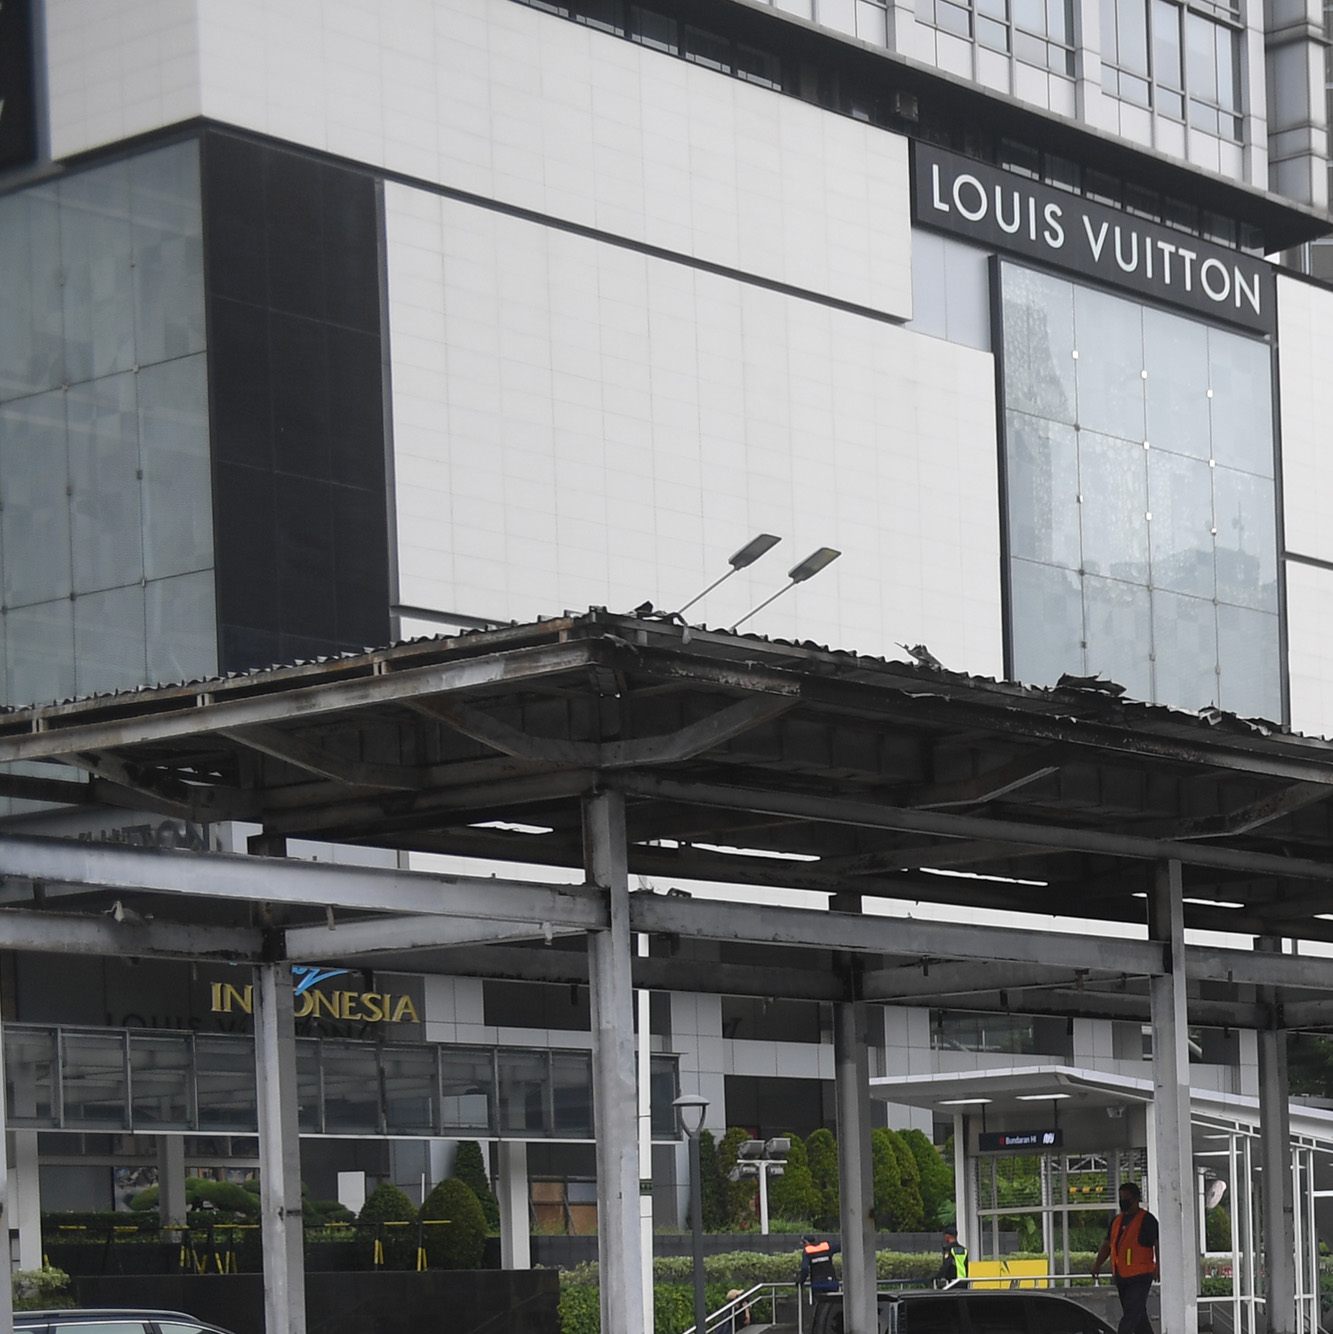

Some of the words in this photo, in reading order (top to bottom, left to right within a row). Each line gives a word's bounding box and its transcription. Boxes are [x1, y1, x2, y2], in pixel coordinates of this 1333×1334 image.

[932, 164, 1065, 249] LOUIS
[1082, 215, 1261, 315] VUITTON
[211, 982, 420, 1023] INONESIA
